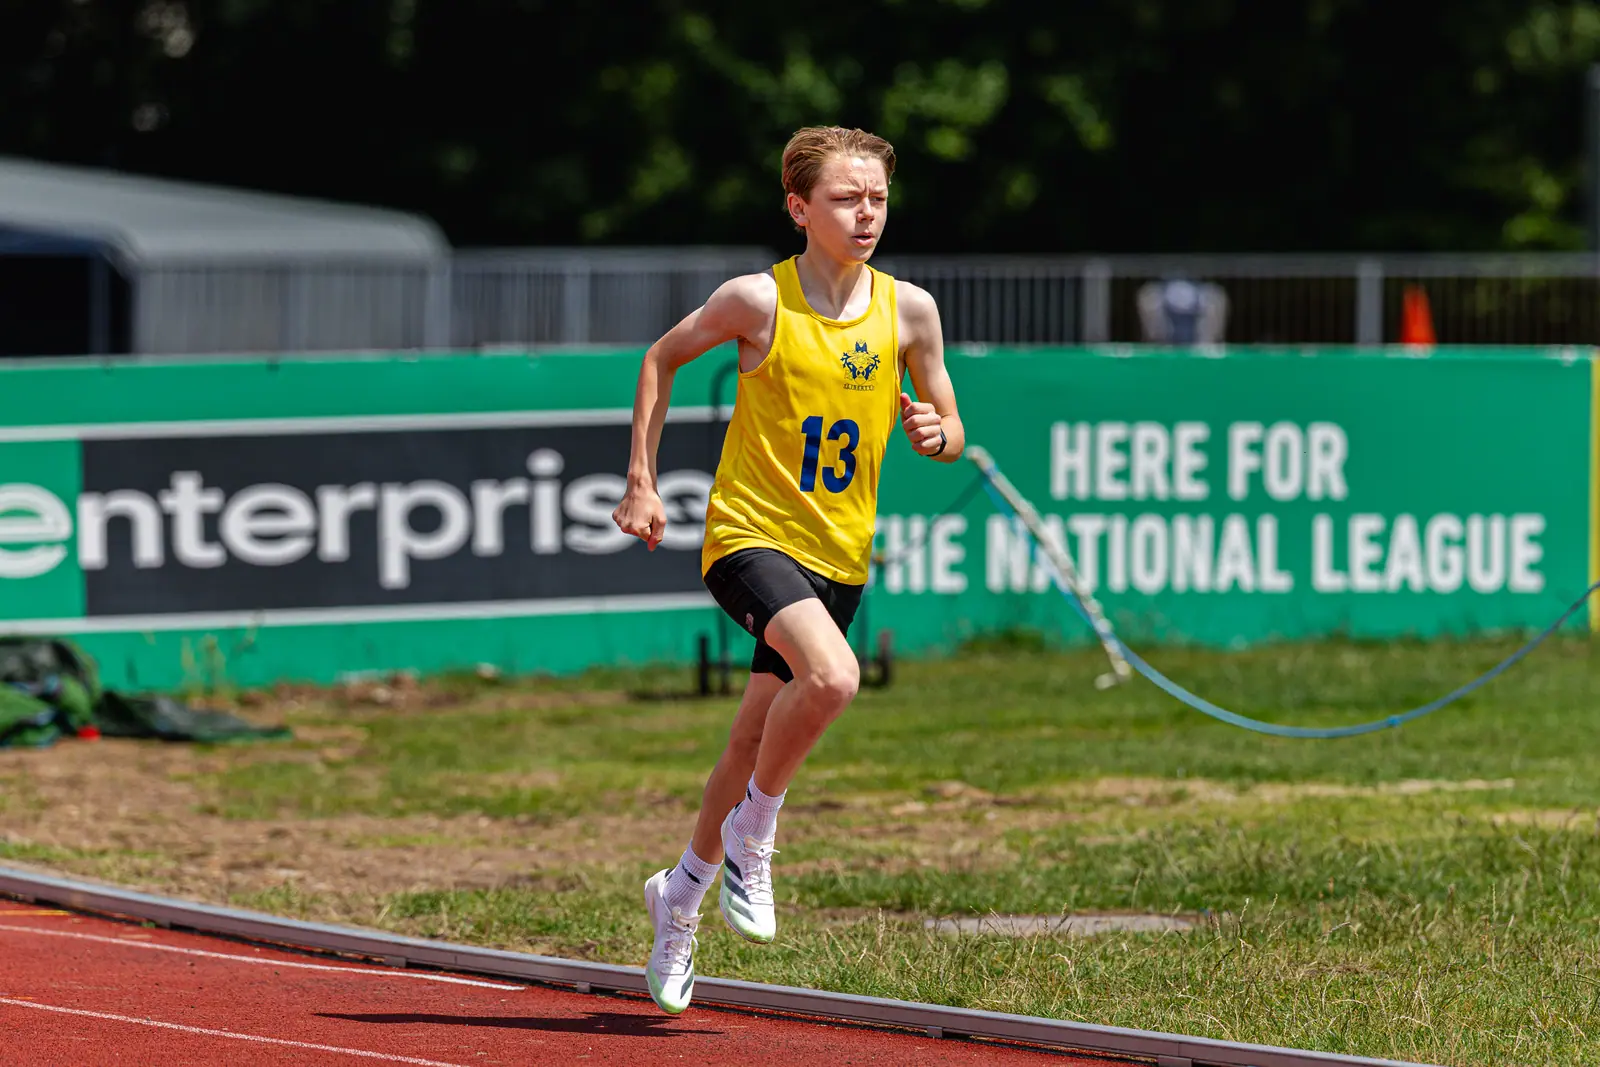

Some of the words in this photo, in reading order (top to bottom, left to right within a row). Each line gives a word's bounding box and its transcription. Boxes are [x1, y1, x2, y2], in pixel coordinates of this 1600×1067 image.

[799, 415, 860, 494] 13
[1050, 421, 1209, 500] HERE
[1227, 421, 1349, 500] FOR
[0, 448, 715, 589] enterprise
[1311, 513, 1546, 594] LEAGUE
